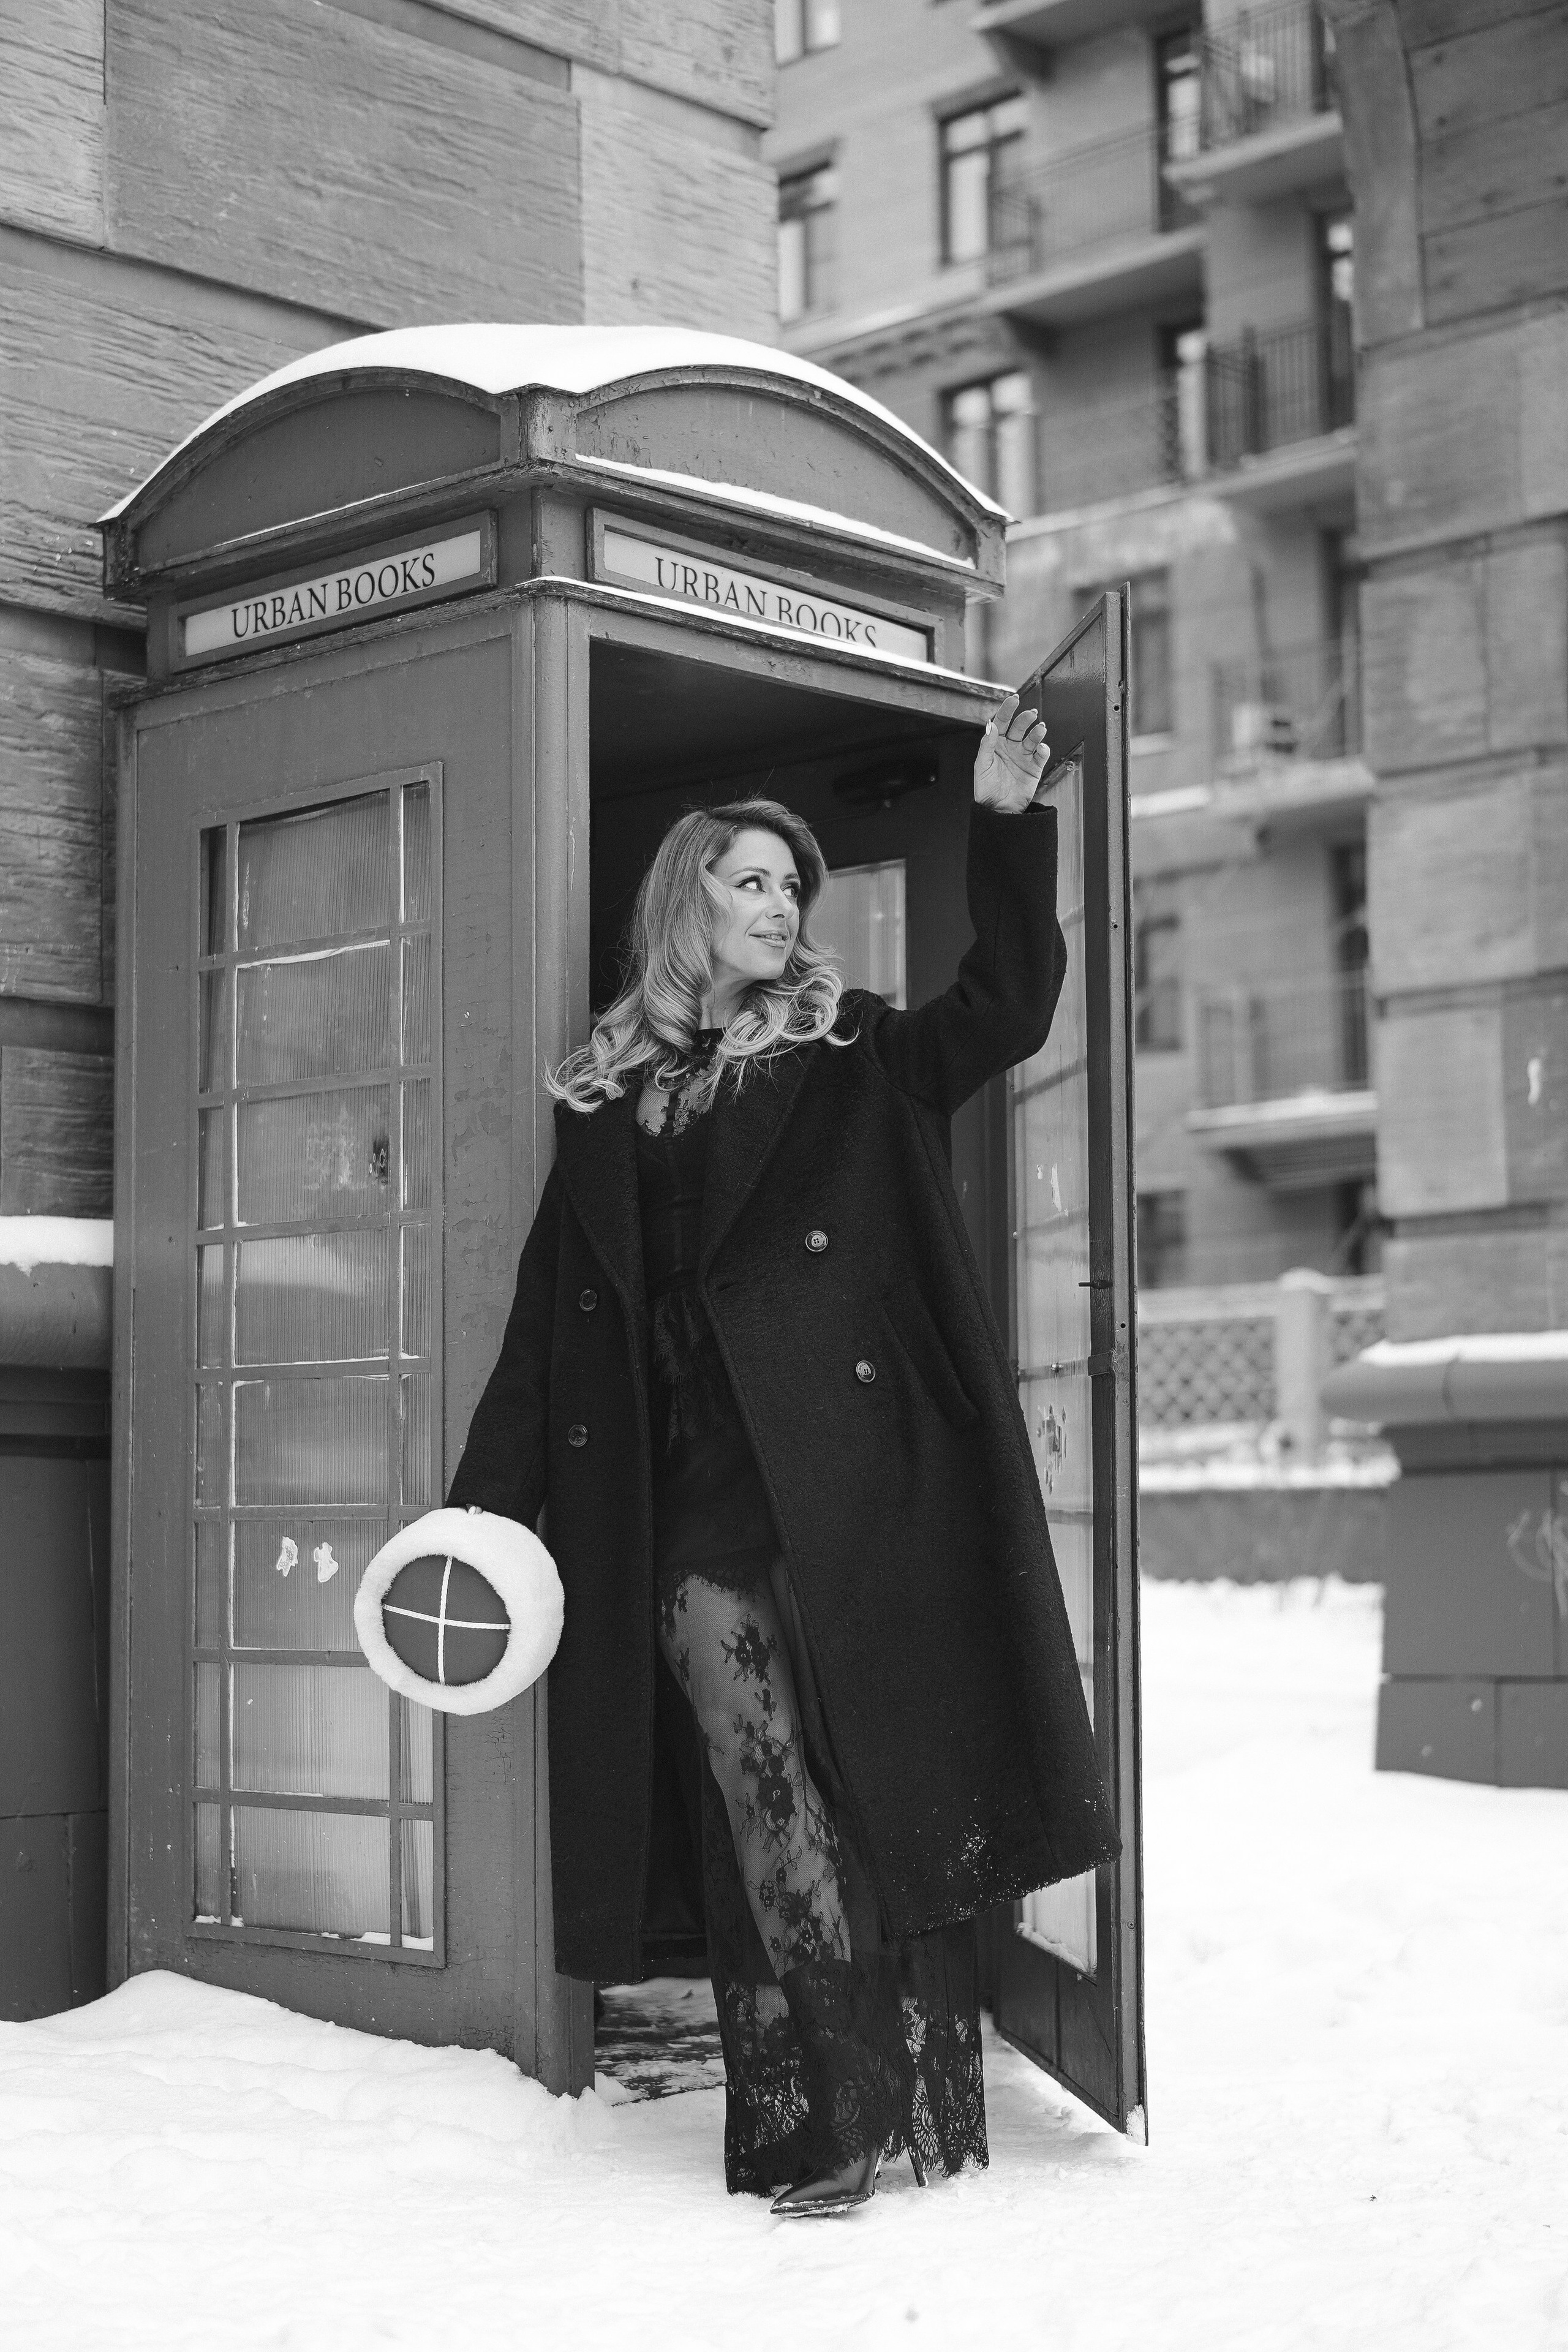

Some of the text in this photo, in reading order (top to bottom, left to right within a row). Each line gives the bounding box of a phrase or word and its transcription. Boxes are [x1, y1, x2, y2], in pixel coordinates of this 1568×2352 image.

[232, 553, 435, 638] URBAN BOOKS
[655, 557, 876, 647] URBAN BOOKS
